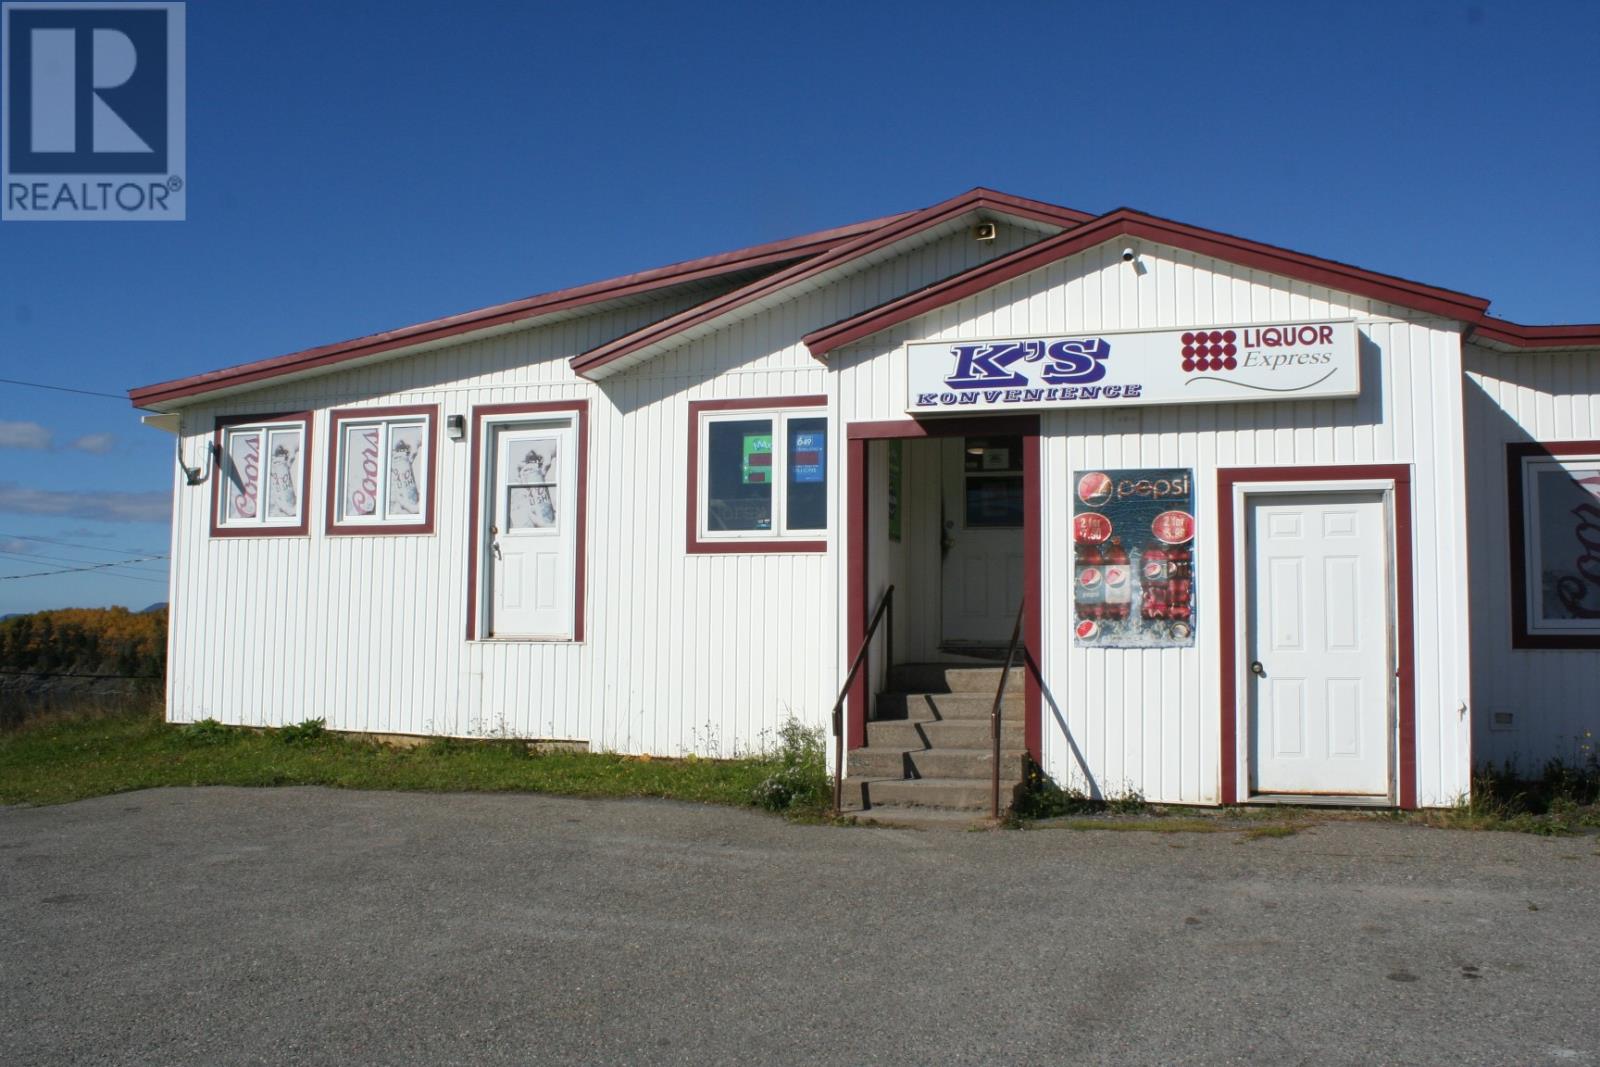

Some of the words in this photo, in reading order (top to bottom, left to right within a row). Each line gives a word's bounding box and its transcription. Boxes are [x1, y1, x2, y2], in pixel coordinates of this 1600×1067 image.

[1244, 325, 1333, 348] LIQUOR
[944, 337, 1111, 389] K'S
[1243, 351, 1332, 370] Express
[916, 384, 1142, 406] KONVENIENCE
[1117, 474, 1190, 499] pepsi
